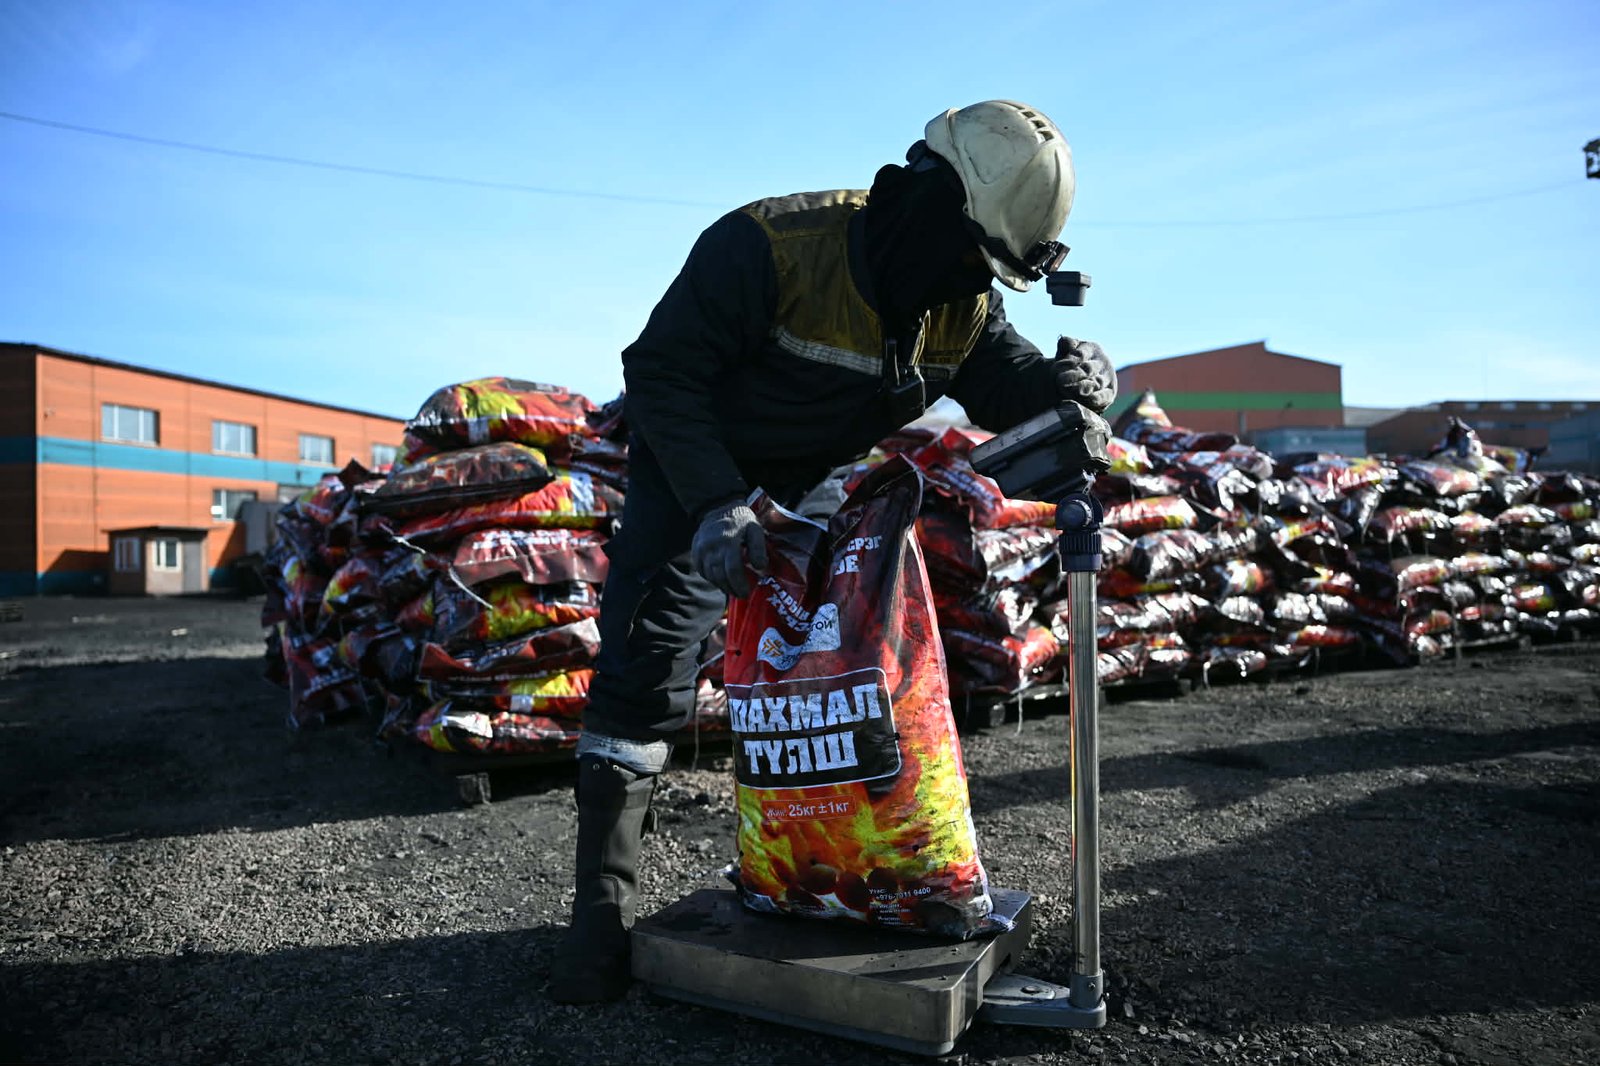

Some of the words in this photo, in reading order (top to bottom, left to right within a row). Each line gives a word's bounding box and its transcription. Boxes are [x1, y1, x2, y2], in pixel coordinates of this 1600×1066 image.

[728, 682, 882, 732] ШАХМАЛ
[743, 731, 859, 775] ТҮЛШ
[788, 804, 815, 817] 25кг
